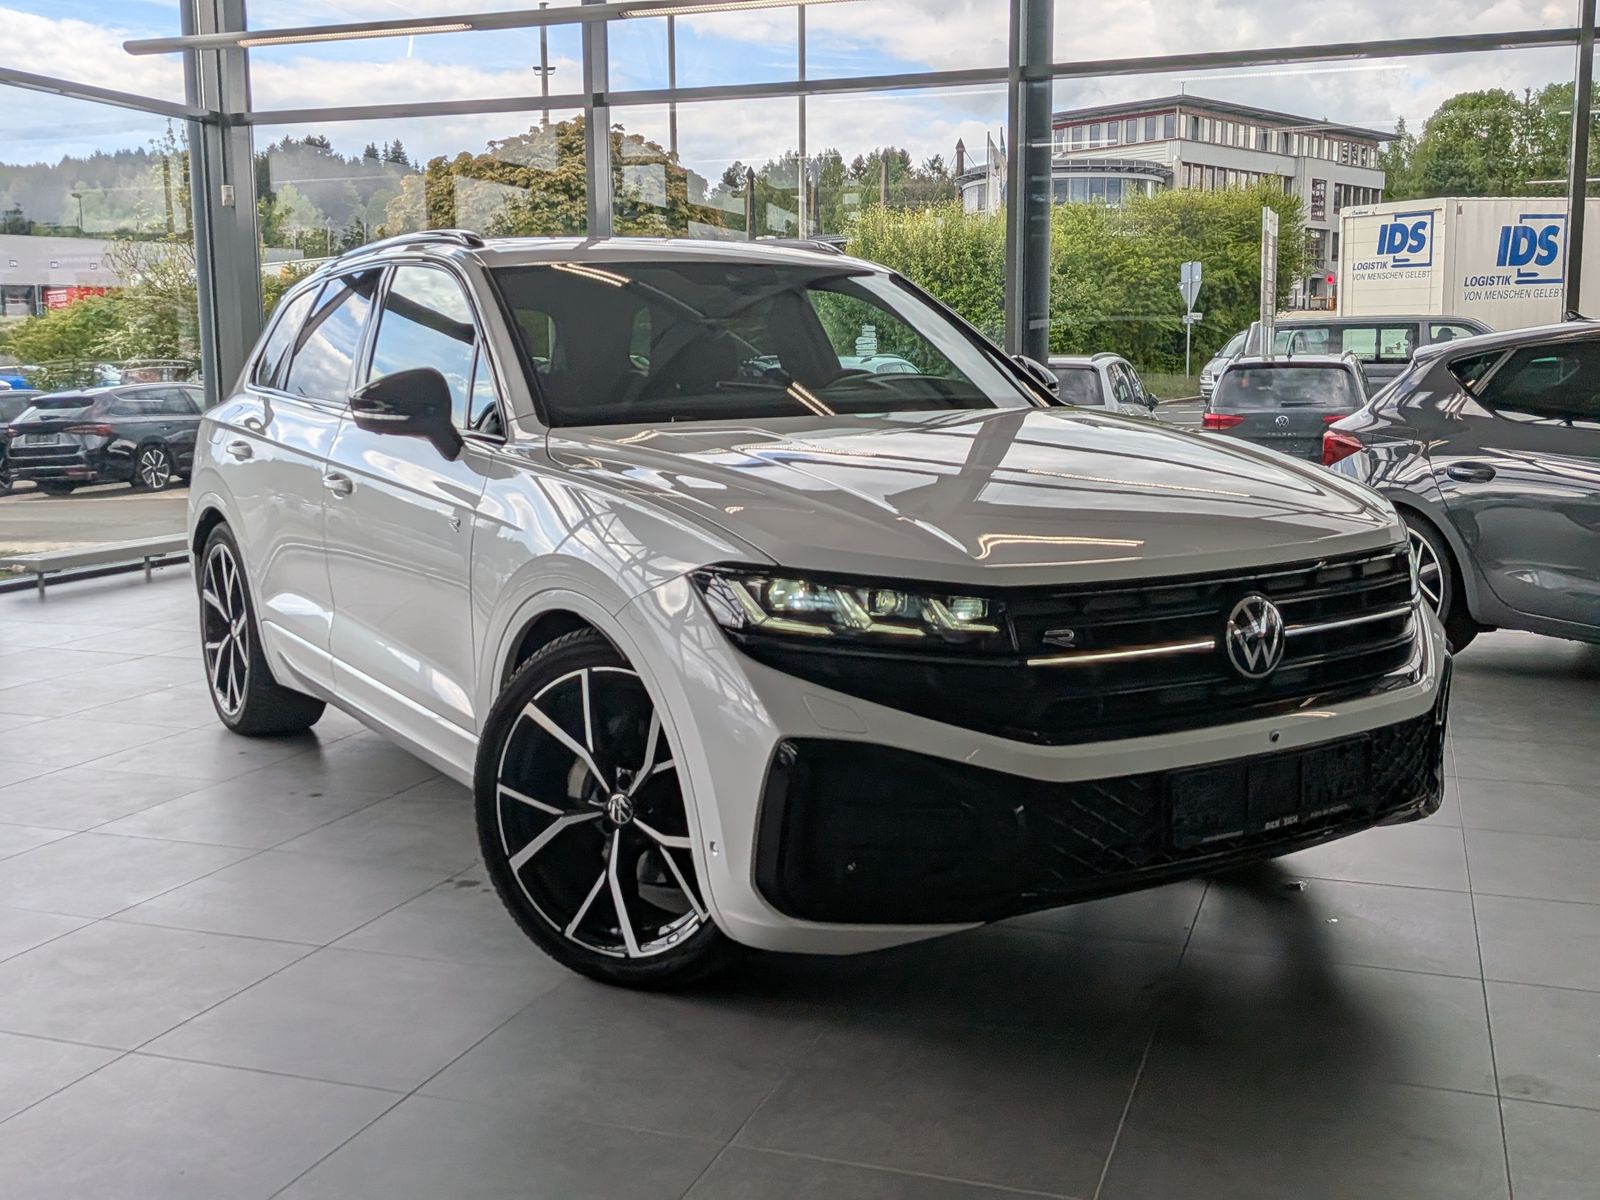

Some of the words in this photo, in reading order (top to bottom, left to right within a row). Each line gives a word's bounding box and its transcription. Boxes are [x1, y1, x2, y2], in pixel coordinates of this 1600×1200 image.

[1376, 220, 1428, 255] IDS
[1496, 224, 1561, 267] IDS
[1352, 261, 1388, 271] LOGISTIK
[1352, 273, 1366, 281] VON
[1367, 271, 1404, 280] MENSCHEN
[1404, 270, 1432, 278] GELEBT
[1463, 275, 1512, 287] LOGISTIK
[1463, 291, 1482, 301] VON
[1483, 289, 1531, 300] MENSCHEN
